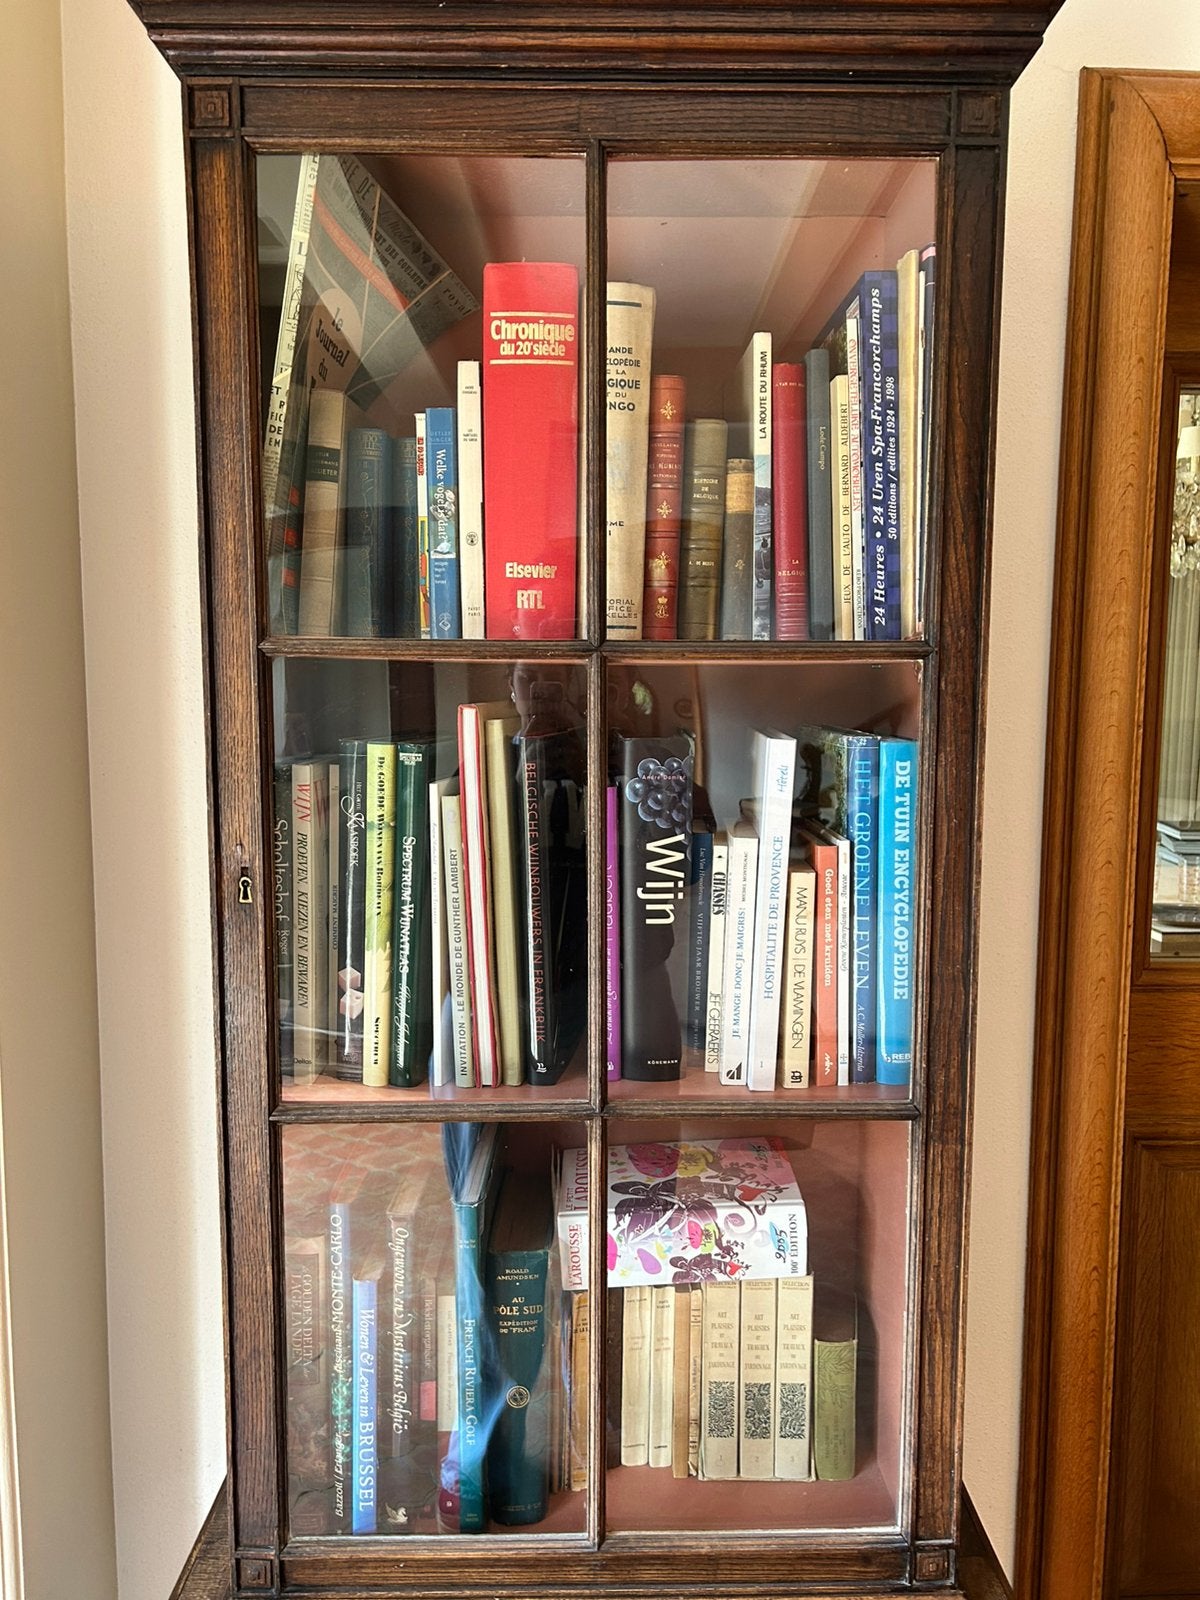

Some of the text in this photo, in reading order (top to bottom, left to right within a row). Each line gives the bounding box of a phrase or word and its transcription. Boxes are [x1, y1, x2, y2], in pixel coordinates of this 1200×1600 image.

[314, 317, 349, 368] Journal
[490, 319, 575, 342] Chronique
[500, 341, 567, 356] du siècle
[269, 424, 283, 435] DE
[759, 351, 768, 439] LA ROUTE DU RHUM
[436, 449, 447, 480] Welke
[869, 287, 886, 626] 24 Heures 24 Uren Spa-Francorchamps
[885, 376, 898, 540] 50 éditions 1924 1998
[434, 482, 446, 506] vogel
[840, 403, 852, 604] JEUX DE L'AUTO DE BERNARD ALDEBERT
[437, 519, 449, 540] dat?
[505, 562, 557, 579] Elsevier
[516, 589, 545, 609] RTL
[377, 771, 386, 812] GOEDE
[526, 762, 539, 838] BELGISCHE
[275, 819, 290, 922] Scholteshof
[294, 783, 311, 1009] WIJN PROEVEN, KIEZEN EN BEWAREN
[636, 833, 686, 925] Wijn
[712, 871, 726, 916] CHASSES
[769, 835, 784, 901] PROVENCE
[854, 760, 872, 990] HET GROENE LEVEN
[893, 760, 911, 1001] DE TUIN ENCYCLOPEDIE
[279, 929, 290, 955] Roger
[695, 912, 705, 945] VIJFTIG
[768, 902, 779, 919] DE
[824, 868, 835, 987] Goed eten met kruiden
[450, 849, 468, 1076] INVITATION LE MONDE DE GUNTHER LAMBERT
[533, 950, 543, 964] IN
[791, 886, 808, 1049] MANU RUYS DE VLAMINGEN
[533, 969, 546, 1043] FRANKRIJK
[732, 956, 746, 1039] JE MANGE DONC JE
[568, 1224, 583, 1287] LAROUSSE
[775, 1229, 788, 1264] 2005
[788, 1213, 799, 1258] ÉDITION
[291, 1273, 302, 1366] LAGE LANDEN
[302, 1274, 313, 1366] GOUDEN DELTA
[387, 1227, 412, 1434] Ongewoon en Mysterieus België
[494, 1305, 543, 1316] PÔLE SUD
[359, 1309, 375, 1512] Wonen & Leven in BRUSSEL
[464, 1319, 478, 1446] FRENCH RIVIERA GOLF
